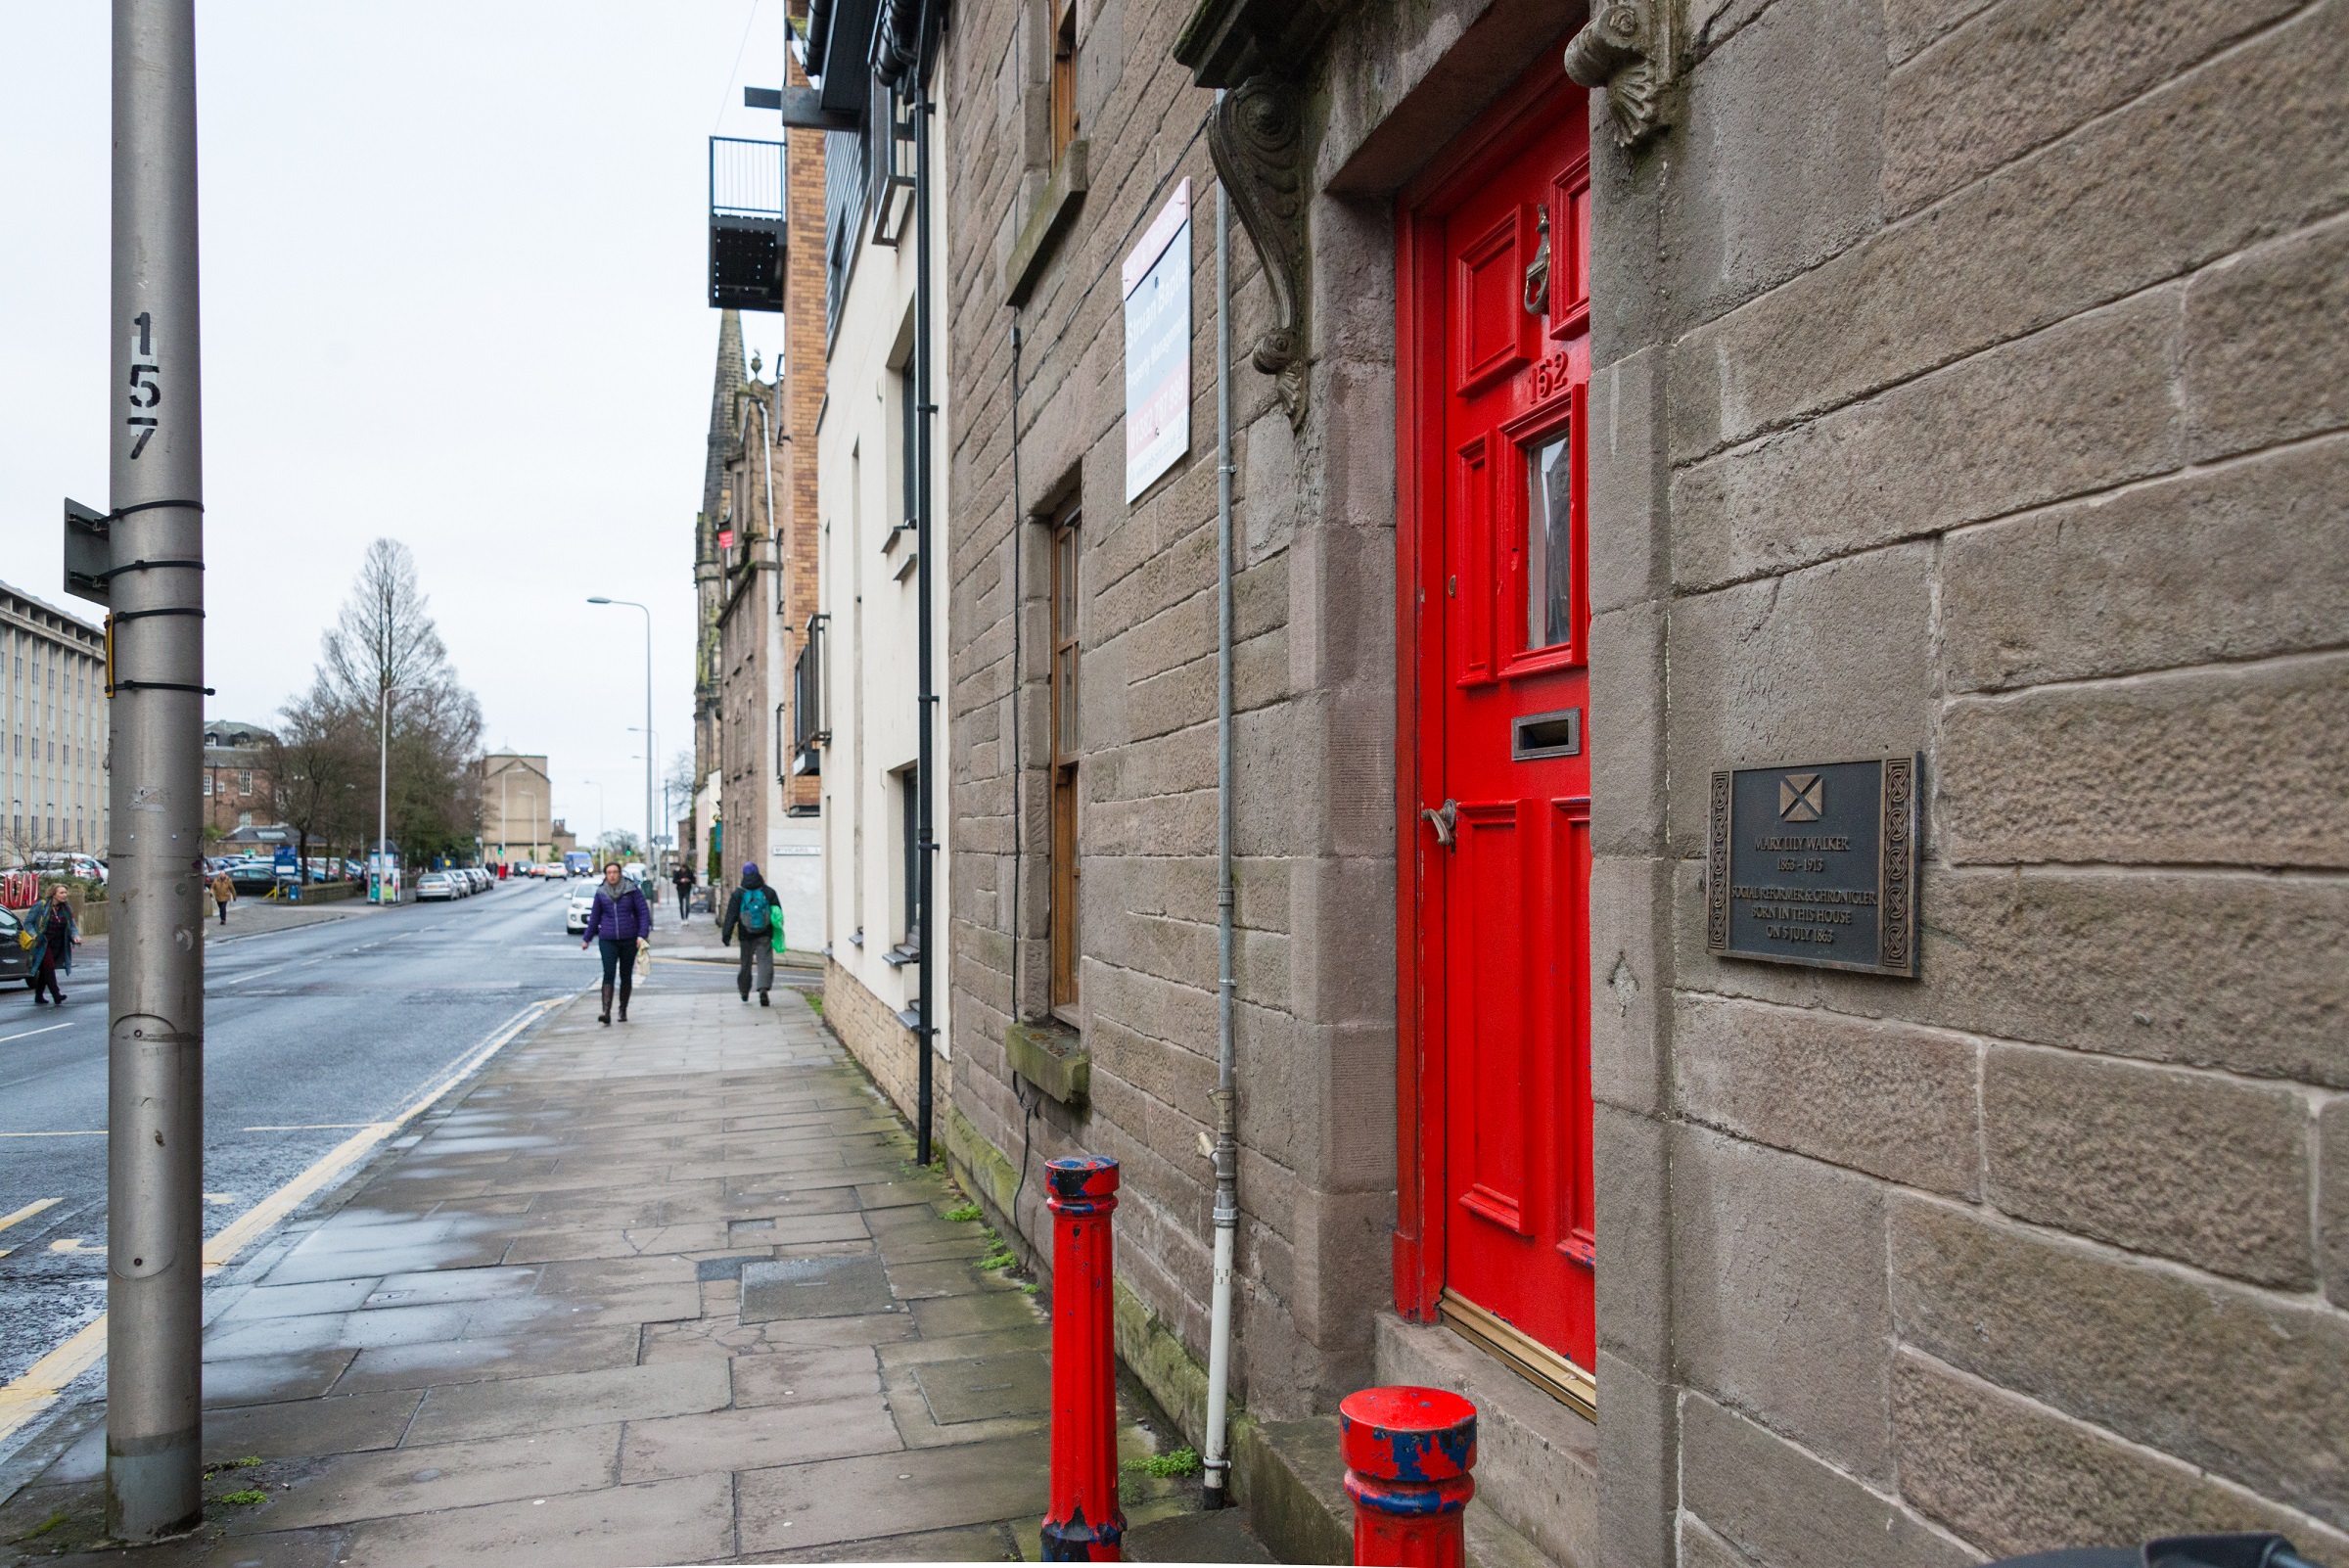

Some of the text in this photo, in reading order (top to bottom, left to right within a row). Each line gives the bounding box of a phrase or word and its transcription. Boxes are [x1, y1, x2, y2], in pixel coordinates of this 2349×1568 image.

[1149, 193, 1184, 250] Managed
[1127, 257, 1187, 350] Struan Baptie
[1127, 311, 1187, 391] Property Management
[1529, 350, 1569, 405] 152
[126, 311, 161, 460] 157
[1129, 372, 1184, 451] 01382 787 999
[1754, 836, 1851, 852] MARY LILY WALKER
[1776, 856, 1796, 872] 1863
[1803, 856, 1823, 872] 1913
[1730, 885, 1878, 905] SOCIAL REFORMER & CHRONICLER
[1751, 905, 1852, 924] BORN IN THIS HOUSE
[1766, 925, 1834, 943] ON 5 JULY 1863
